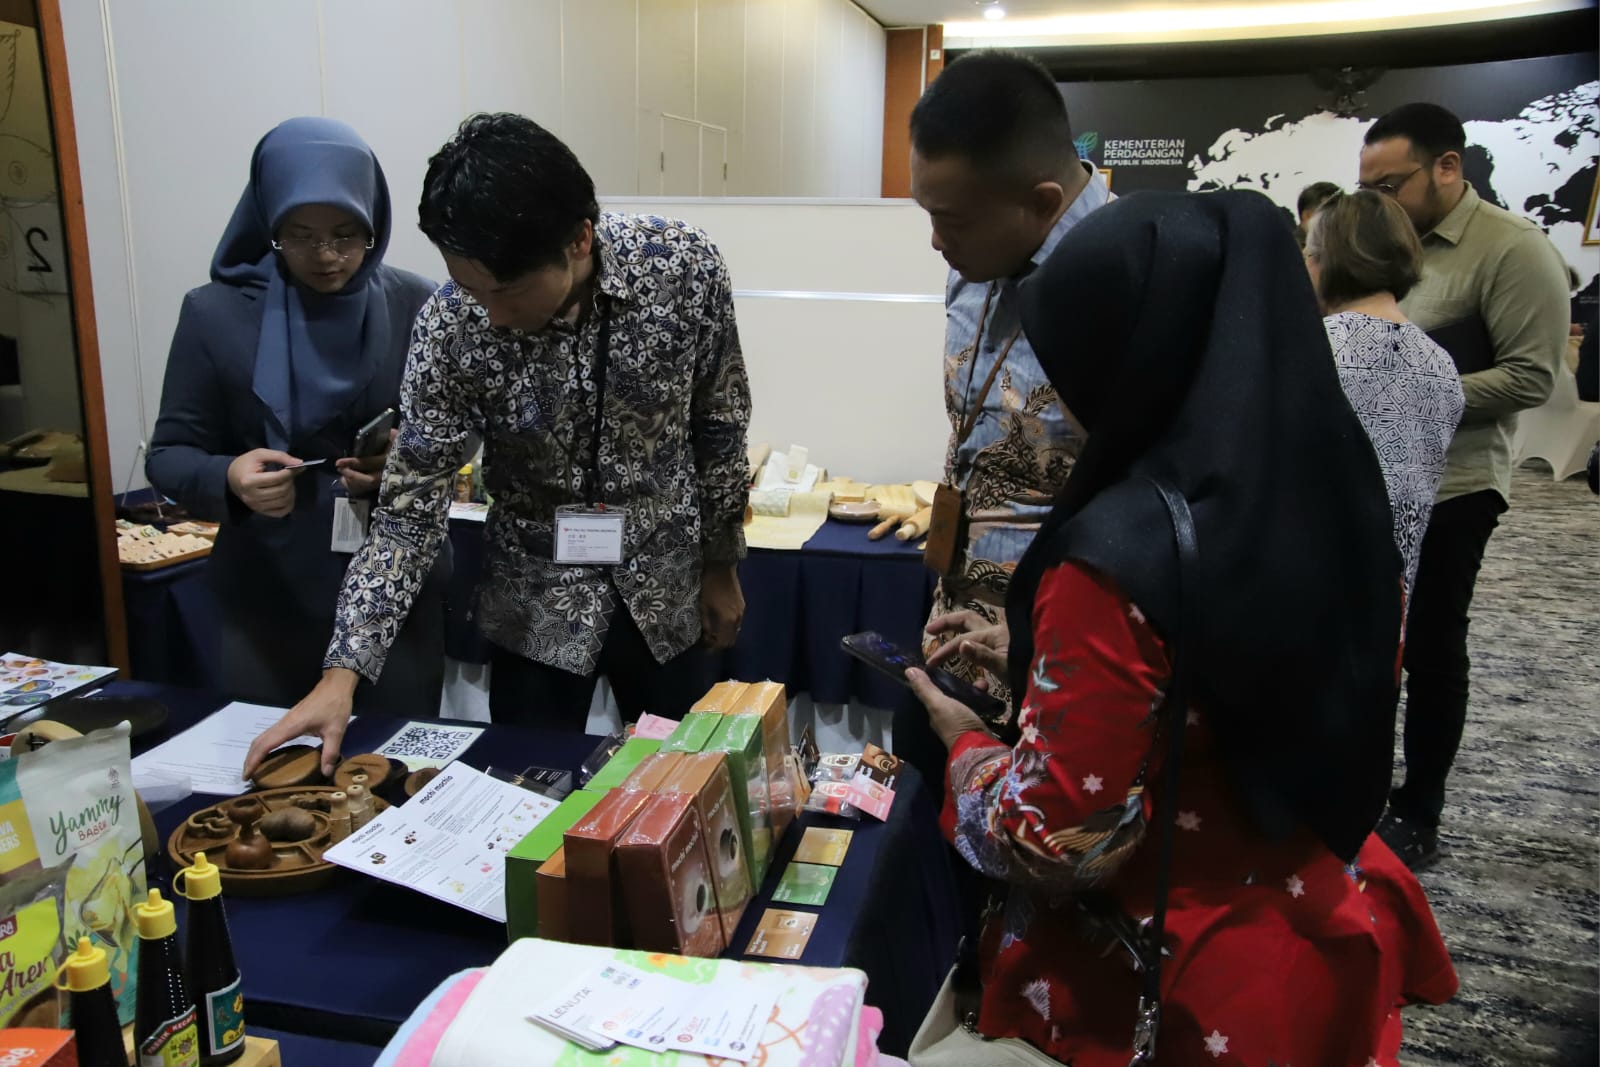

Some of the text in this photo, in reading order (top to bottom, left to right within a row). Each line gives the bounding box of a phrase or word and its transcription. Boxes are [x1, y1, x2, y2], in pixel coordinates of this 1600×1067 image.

[1103, 139, 1185, 150] KEMENTERIAN
[1103, 149, 1185, 159] PERDAGANGAN
[418, 774, 454, 805] mochi mochio
[49, 795, 125, 855] Yammy
[0, 956, 48, 1000] Aren
[549, 986, 592, 1020] LENUTA
